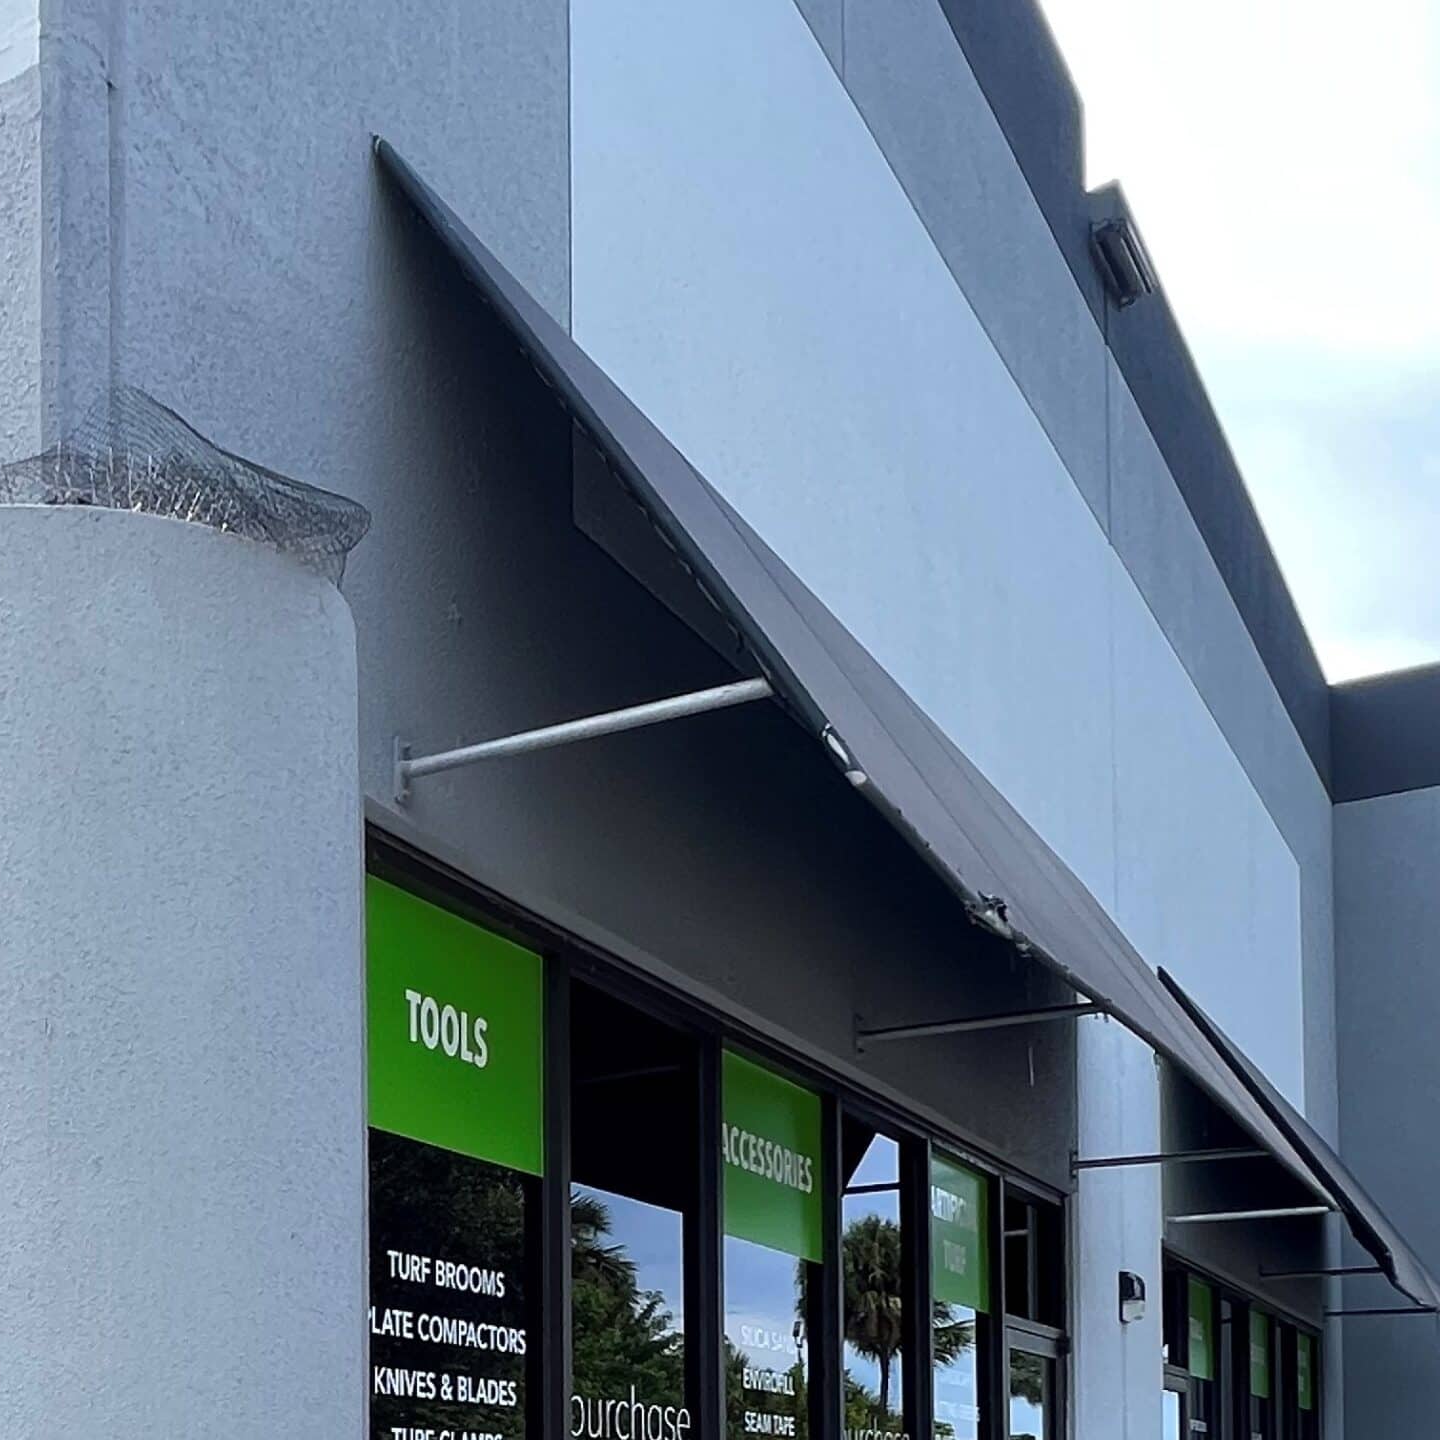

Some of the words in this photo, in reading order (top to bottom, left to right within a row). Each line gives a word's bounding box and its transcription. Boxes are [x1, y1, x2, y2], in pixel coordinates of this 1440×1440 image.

[405, 988, 488, 1069] TOOLS
[722, 1122, 812, 1194] ACCESSORIES
[386, 1249, 432, 1284] TURF
[435, 1259, 505, 1298] BROOMS
[367, 1305, 415, 1339] LATE
[417, 1313, 527, 1355] COMPACTORS
[374, 1366, 437, 1400] KNIVES
[440, 1374, 454, 1400] &
[456, 1376, 517, 1406] BLADES
